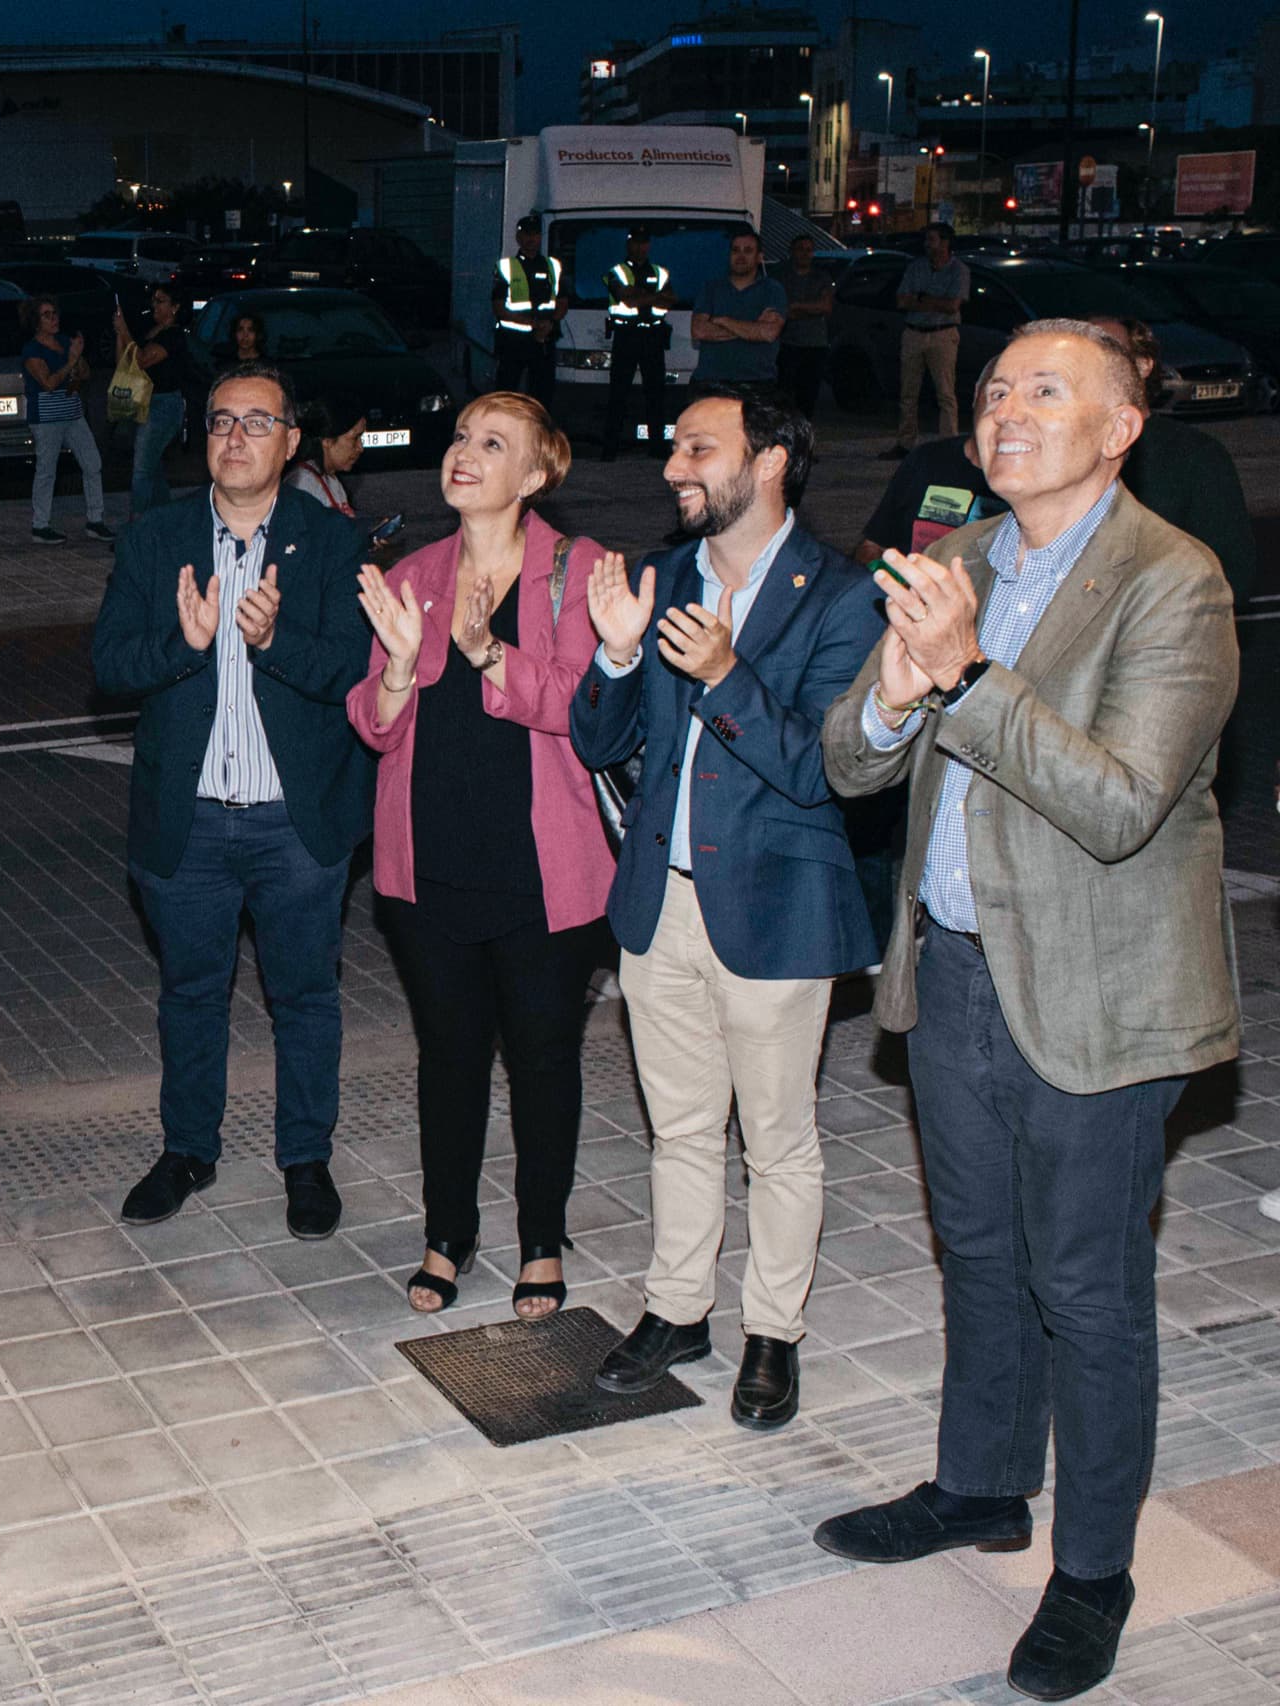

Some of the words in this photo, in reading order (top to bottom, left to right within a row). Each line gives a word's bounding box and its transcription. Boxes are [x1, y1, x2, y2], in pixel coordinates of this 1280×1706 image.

[559, 150, 634, 161] Productos
[641, 149, 731, 162] Alimenticios
[385, 432, 407, 445] DPY
